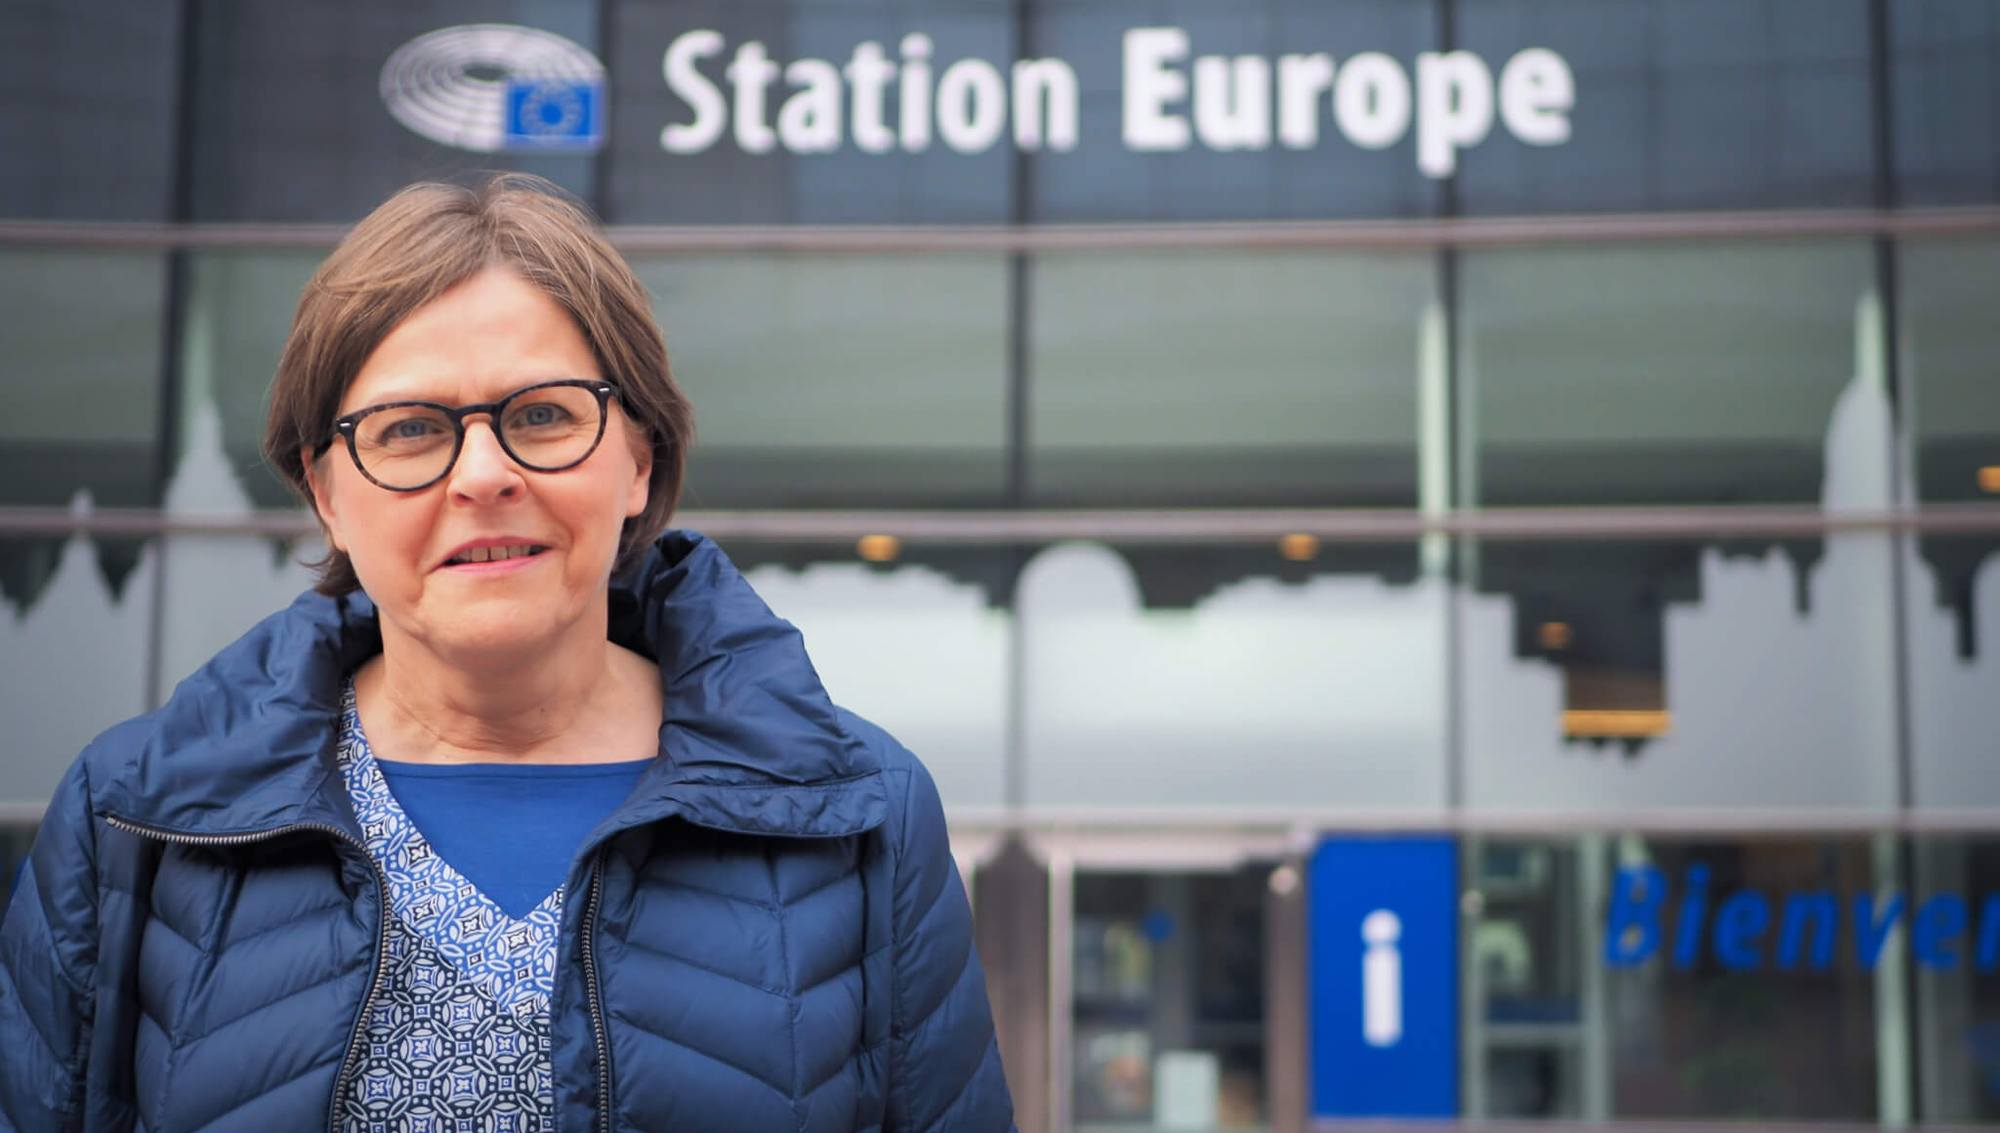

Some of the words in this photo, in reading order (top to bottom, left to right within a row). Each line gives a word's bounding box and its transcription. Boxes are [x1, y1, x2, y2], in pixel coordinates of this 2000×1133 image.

[661, 30, 1078, 152] Station
[1121, 27, 1574, 177] Europe
[1362, 910, 1401, 1045] i
